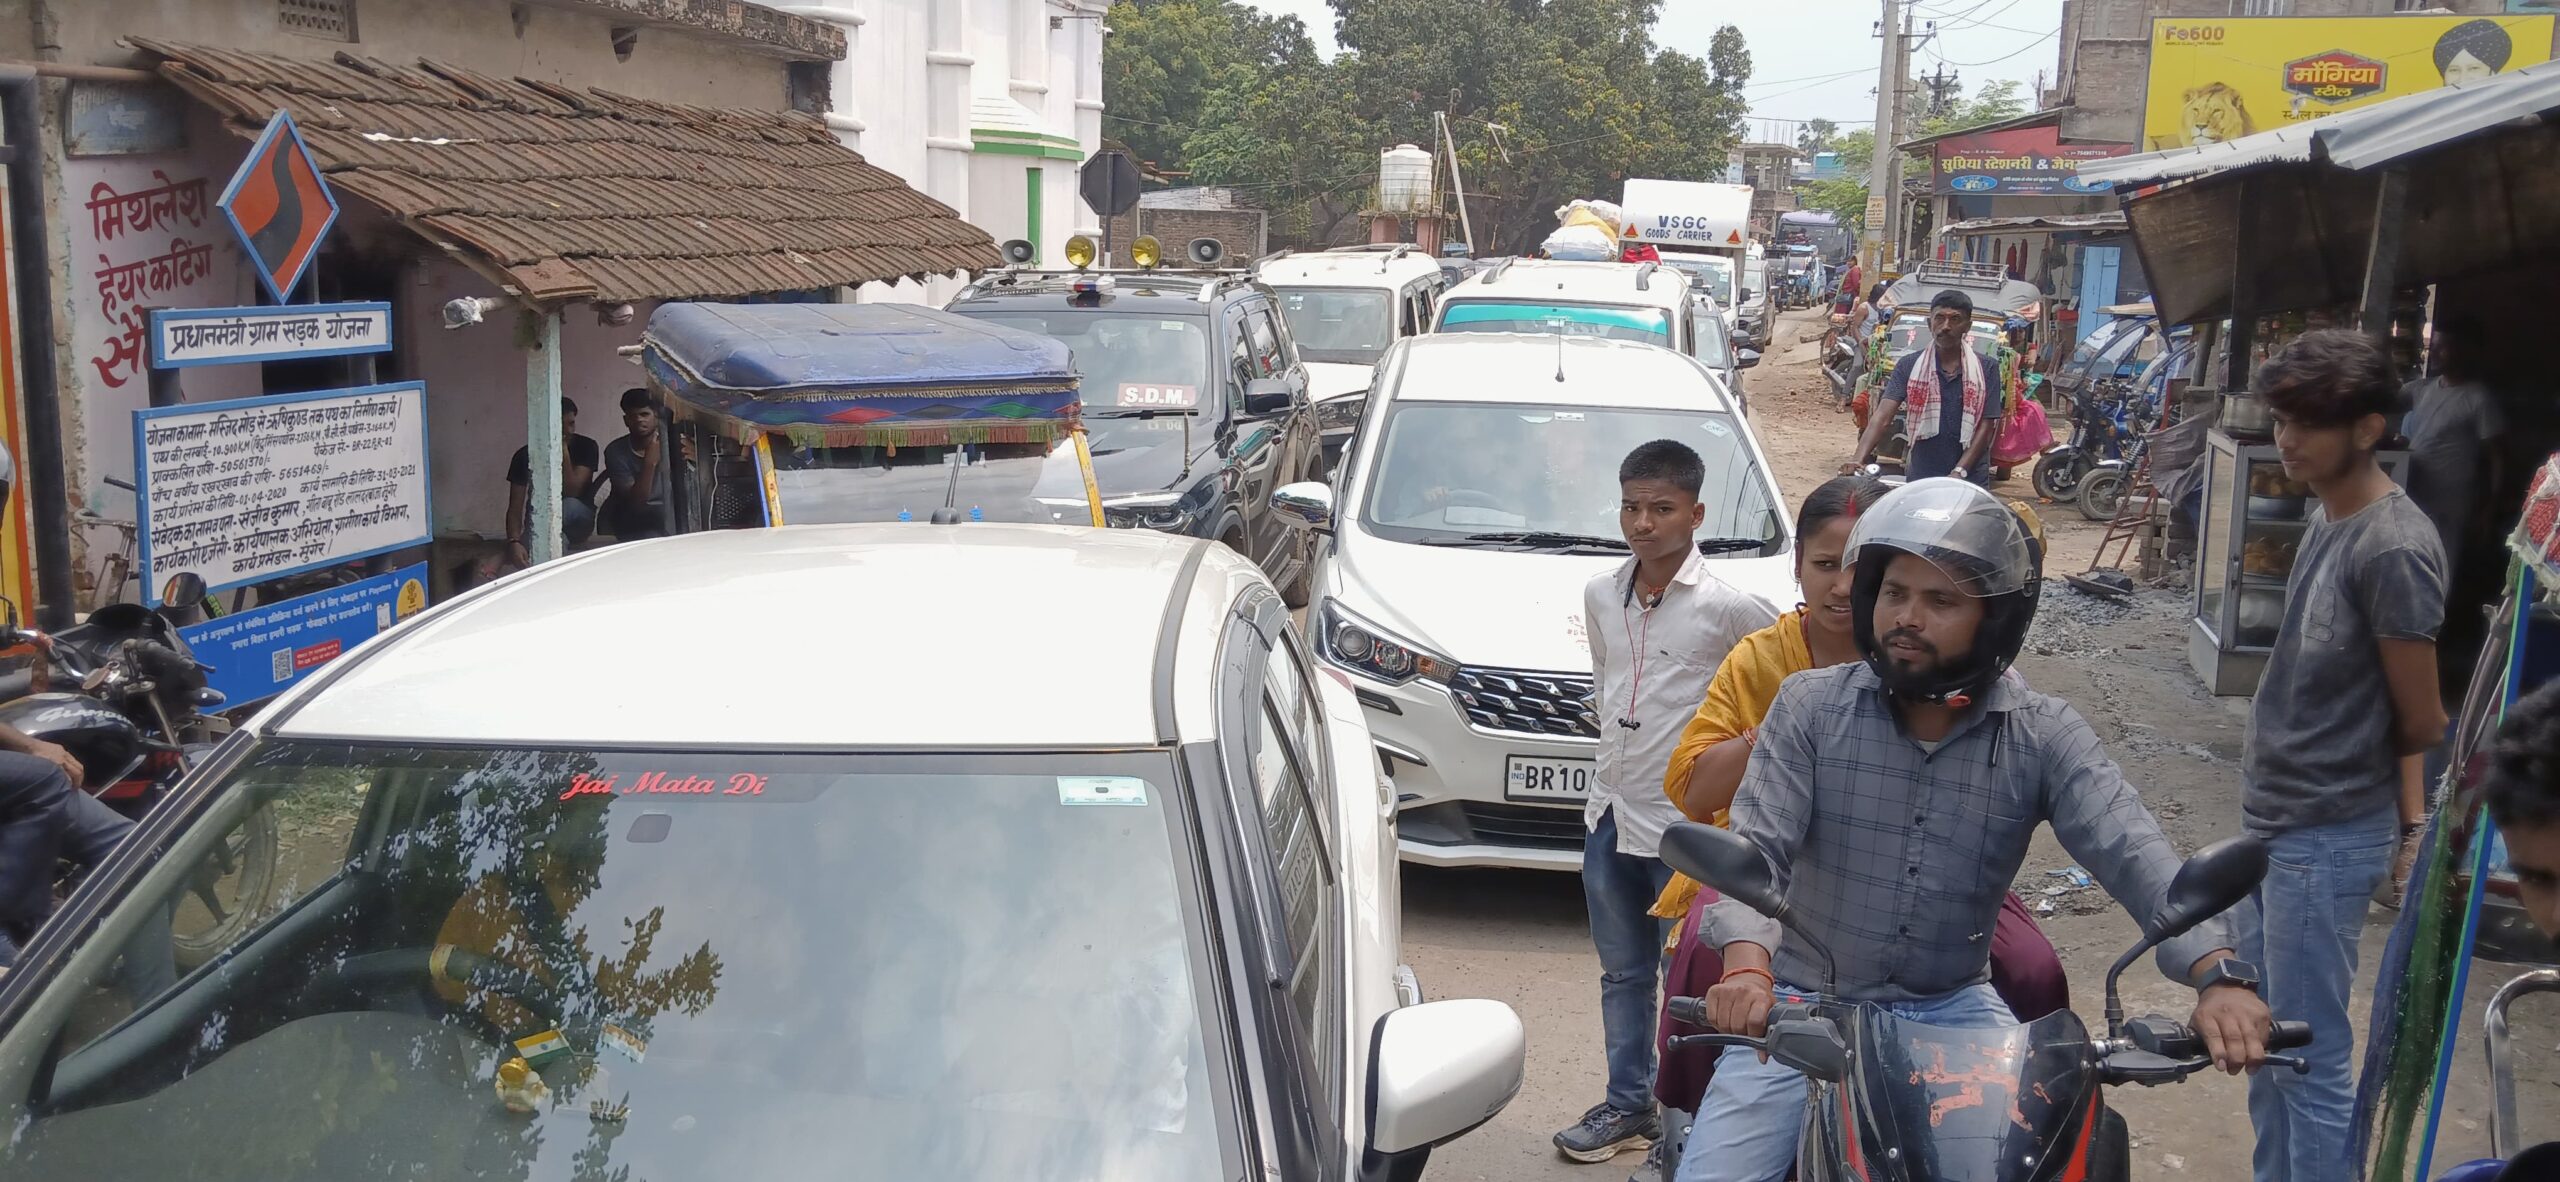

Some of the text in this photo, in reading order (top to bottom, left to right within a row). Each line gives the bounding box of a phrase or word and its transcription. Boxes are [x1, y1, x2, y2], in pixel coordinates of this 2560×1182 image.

[2292, 61, 2378, 84] मोंगिया
[2312, 86, 2353, 98] स्टील
[1942, 156, 1981, 173] सुप्रिया
[1985, 156, 2032, 170] स्टेशनरी
[2037, 158, 2048, 170] &
[85, 170, 208, 242] मिथलेश
[1658, 215, 1707, 230] VSGC
[1645, 228, 1713, 242] GOODS CARRIER
[95, 238, 213, 325] हेयर कटिंग
[170, 313, 373, 353] प्रधानमंत्री ग्राम सड़क योजना
[1125, 386, 1189, 405] S.D.M.
[152, 450, 169, 466] पथ
[170, 445, 183, 463] की
[239, 471, 253, 488] की
[152, 506, 178, 524] कार्य
[300, 476, 319, 494] कार्य
[238, 505, 270, 530] संजीव
[271, 500, 300, 526] कुमार
[232, 554, 257, 573] कार्य
[561, 771, 769, 801] Jai Mata Di
[1525, 765, 1596, 792] BR10
